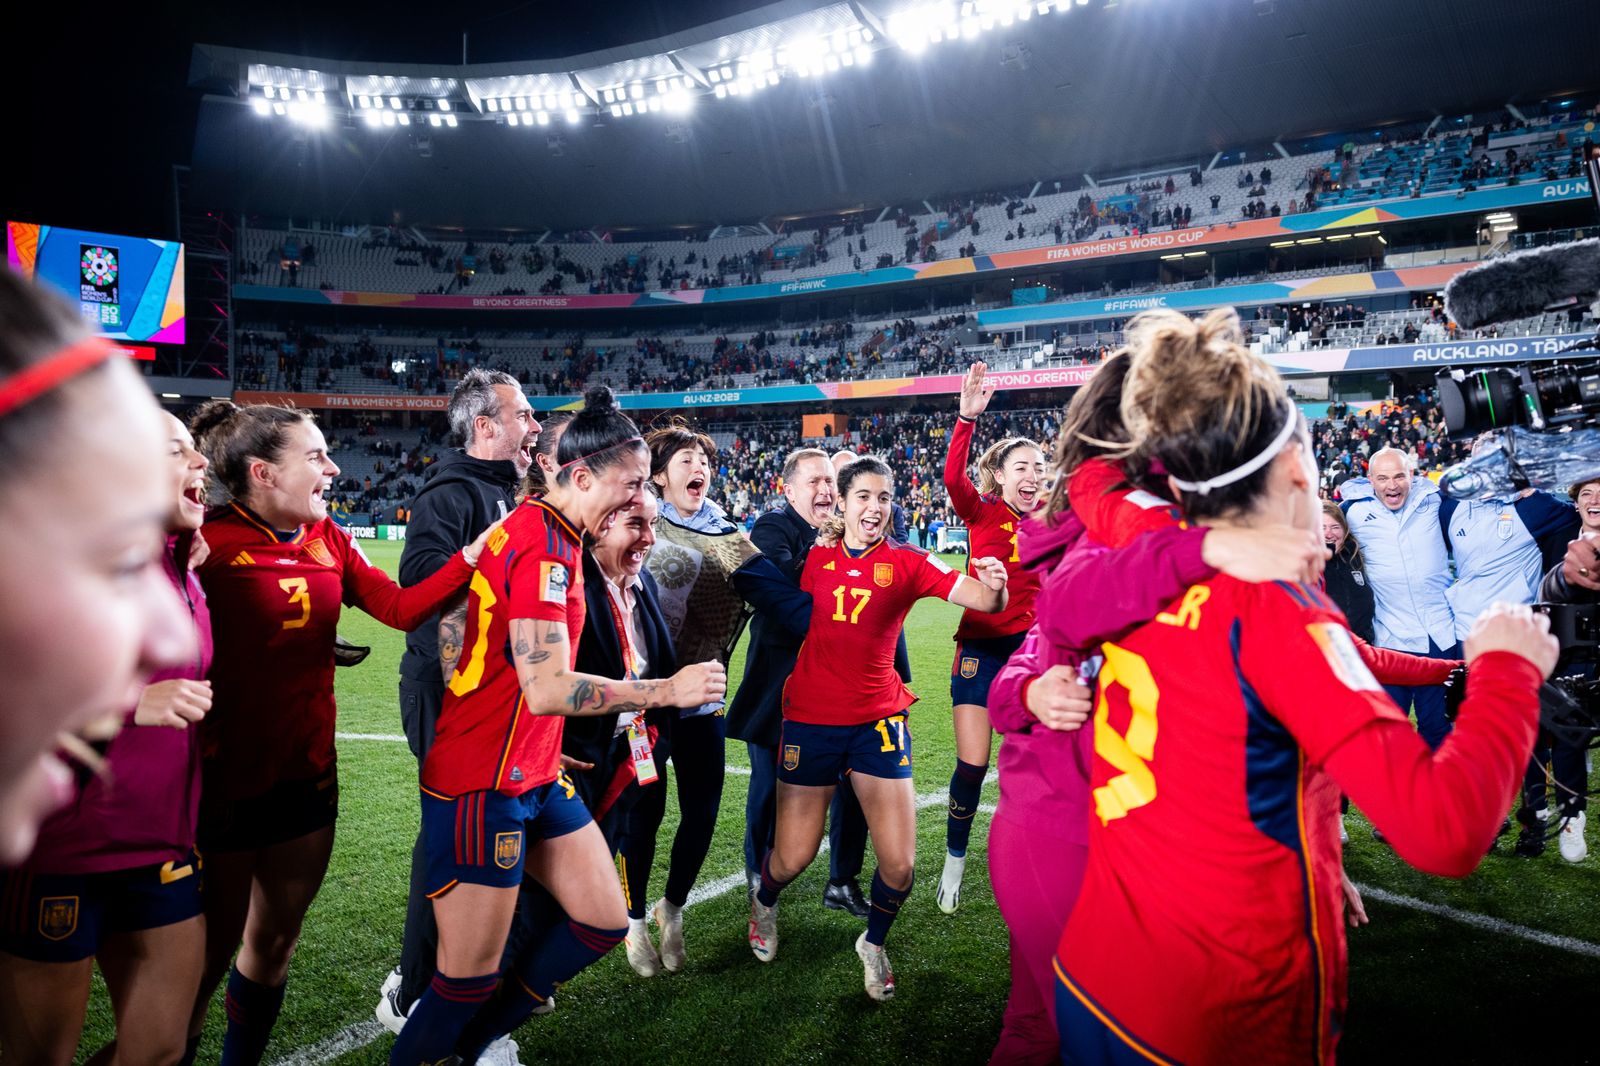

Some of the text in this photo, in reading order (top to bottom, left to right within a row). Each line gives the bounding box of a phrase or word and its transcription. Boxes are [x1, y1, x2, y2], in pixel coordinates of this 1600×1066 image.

[1543, 181, 1590, 197] AU·N
[1047, 231, 1204, 260] FIFA WOMEN'S WORLD CUP
[780, 279, 827, 293] #FIFAWWC
[473, 298, 568, 306] BEYOND GREATNESS
[1104, 296, 1167, 312] #FIFAWWC
[1413, 338, 1595, 362] AUCKLAND TĀM
[983, 370, 1093, 387] BEYOND GREATNE
[326, 396, 445, 408] FIFA WOMEN'S WORLD
[351, 526, 376, 538] STORE
[278, 577, 311, 630] 3
[832, 584, 872, 624] 17
[874, 715, 905, 752] 17
